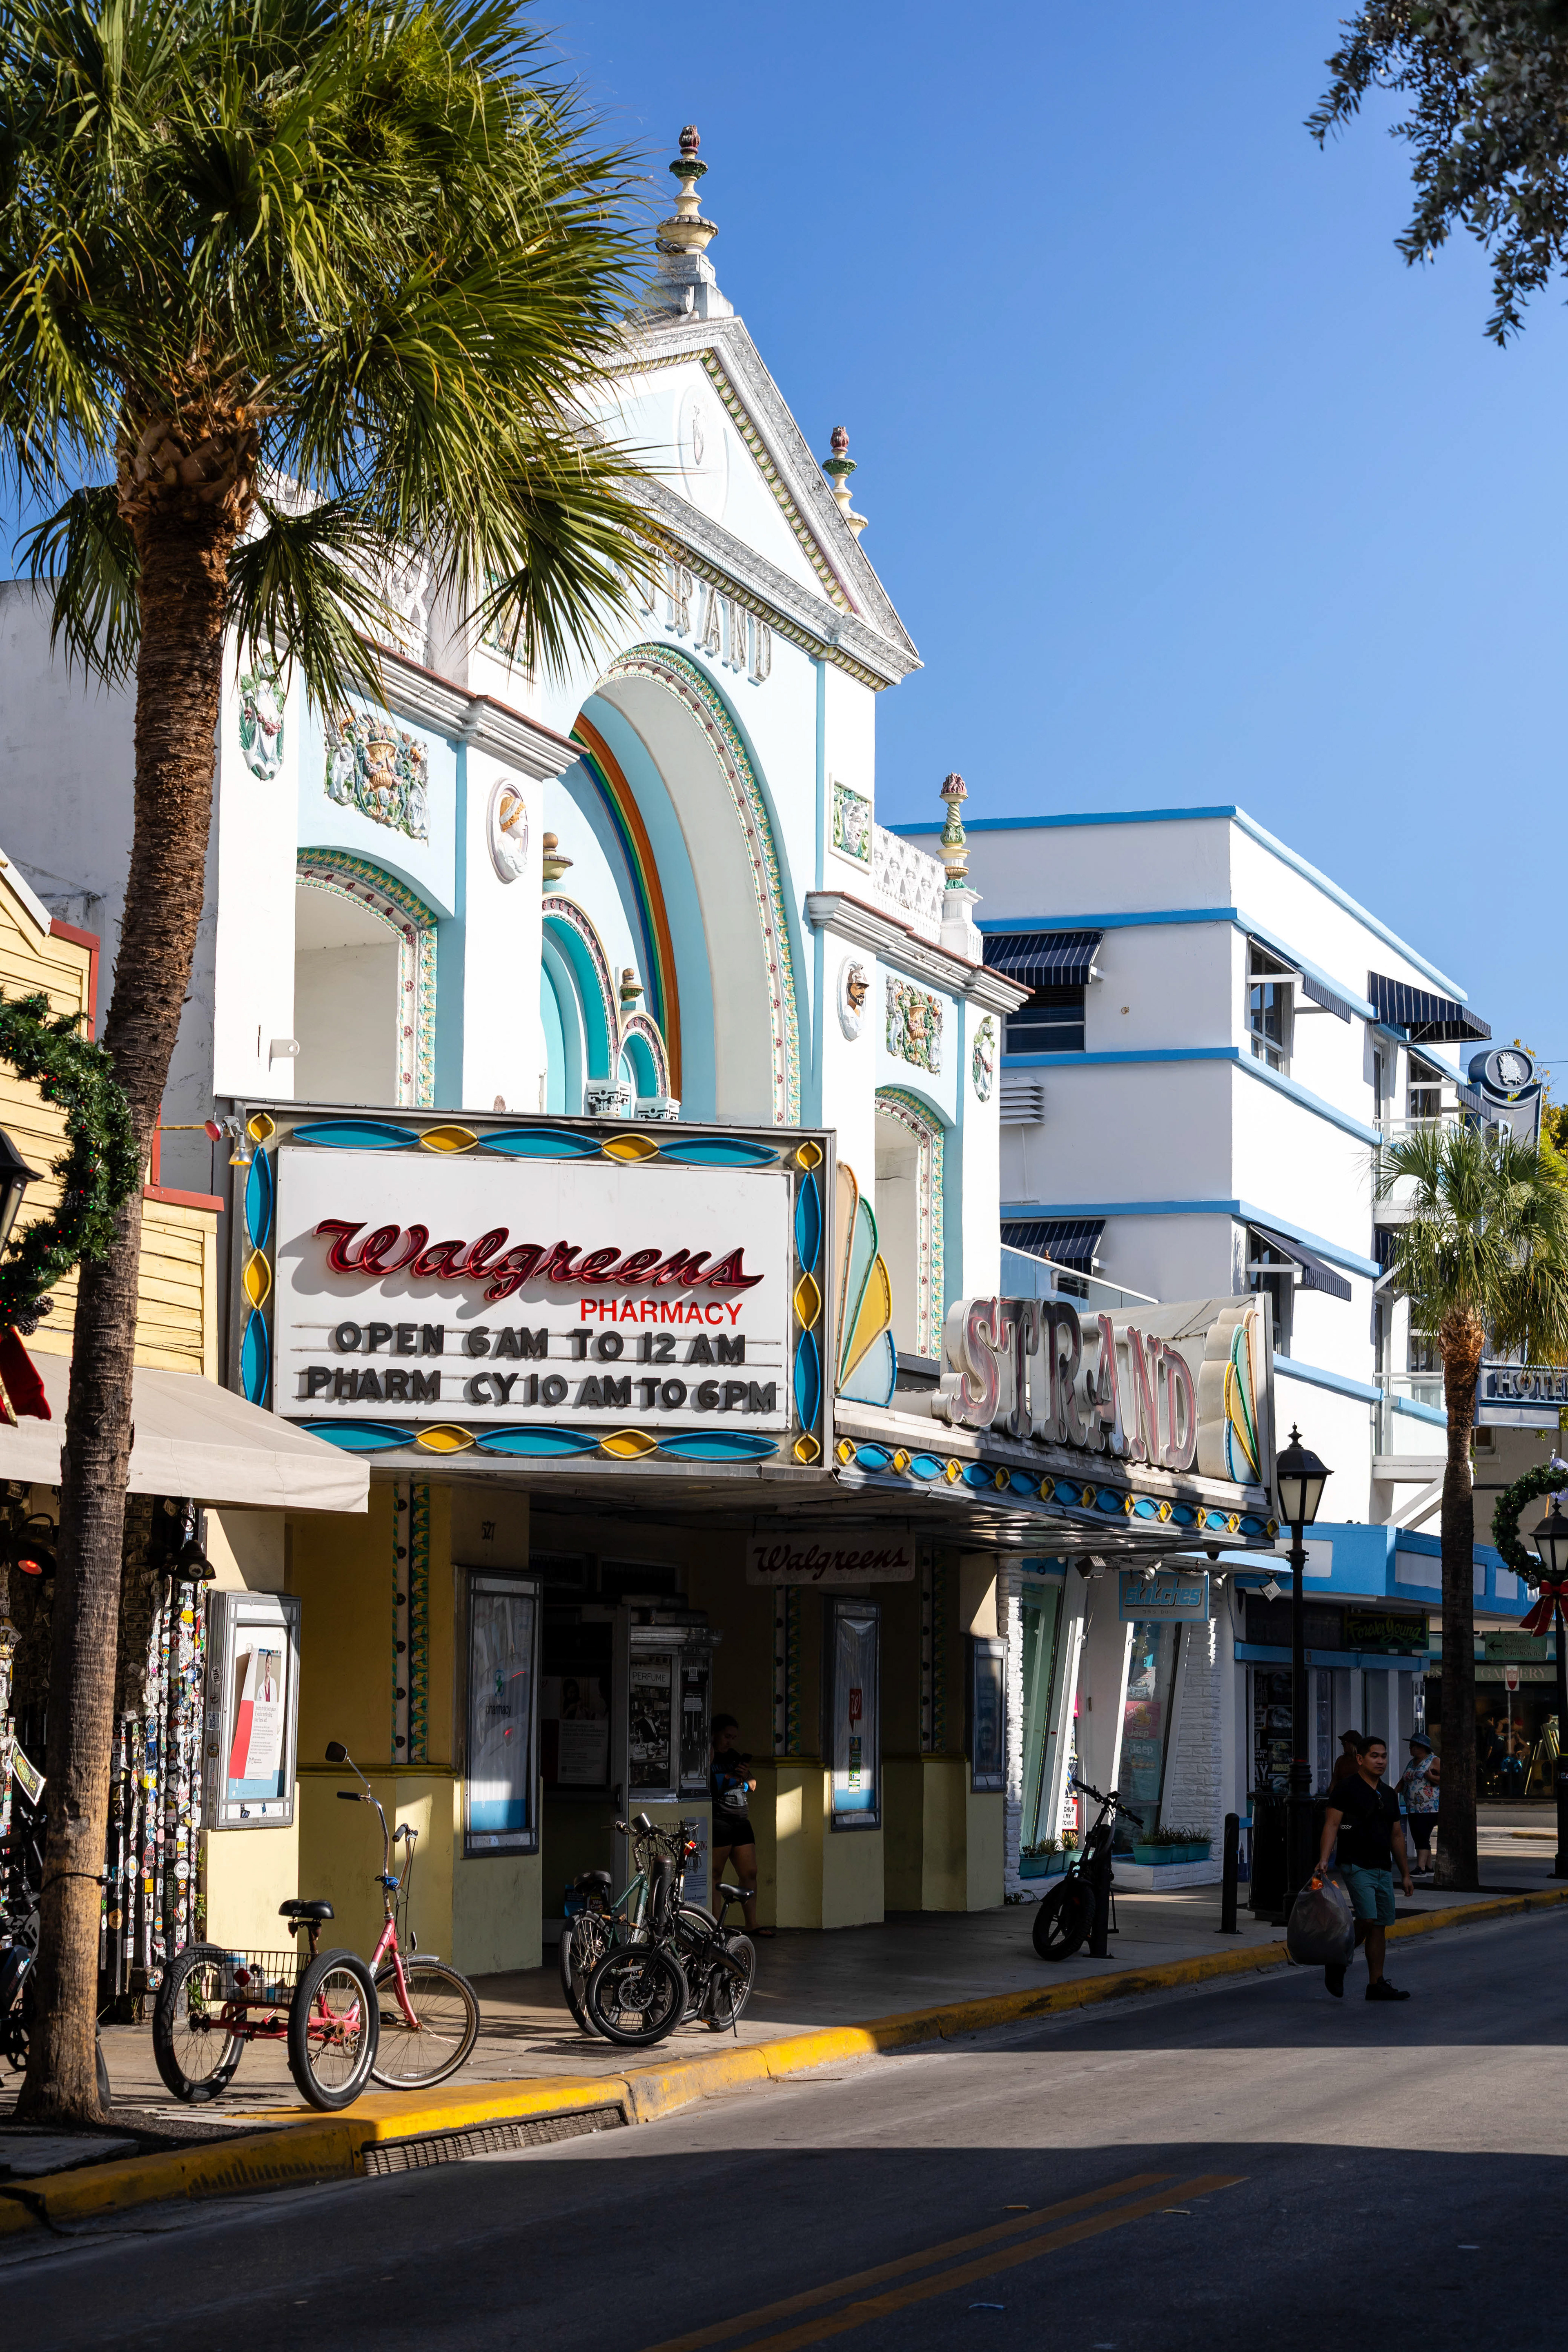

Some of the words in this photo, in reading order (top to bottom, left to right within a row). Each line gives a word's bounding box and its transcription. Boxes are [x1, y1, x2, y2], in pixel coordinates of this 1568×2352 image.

[312, 1218, 764, 1302] Walgreens
[581, 1298, 743, 1326] PHARMACY
[335, 1321, 445, 1355] OPEN
[573, 1328, 624, 1361] TO
[932, 1296, 1198, 1471] STRAND
[1496, 1370, 1568, 1396] HOTE
[482, 1521, 496, 1541] 527
[753, 1544, 910, 1581] Walgreens
[1124, 1577, 1203, 1607] stitches
[1348, 1620, 1385, 1641] Forever
[1379, 1615, 1424, 1646] Young
[633, 1671, 666, 1682] PERFUME
[486, 1703, 511, 1717] pharmacy
[1127, 1730, 1149, 1740] Jeep
[1129, 1744, 1153, 1755] Jeep
[166, 1870, 174, 1879] LE
[680, 1927, 695, 1942] LECTRIC
